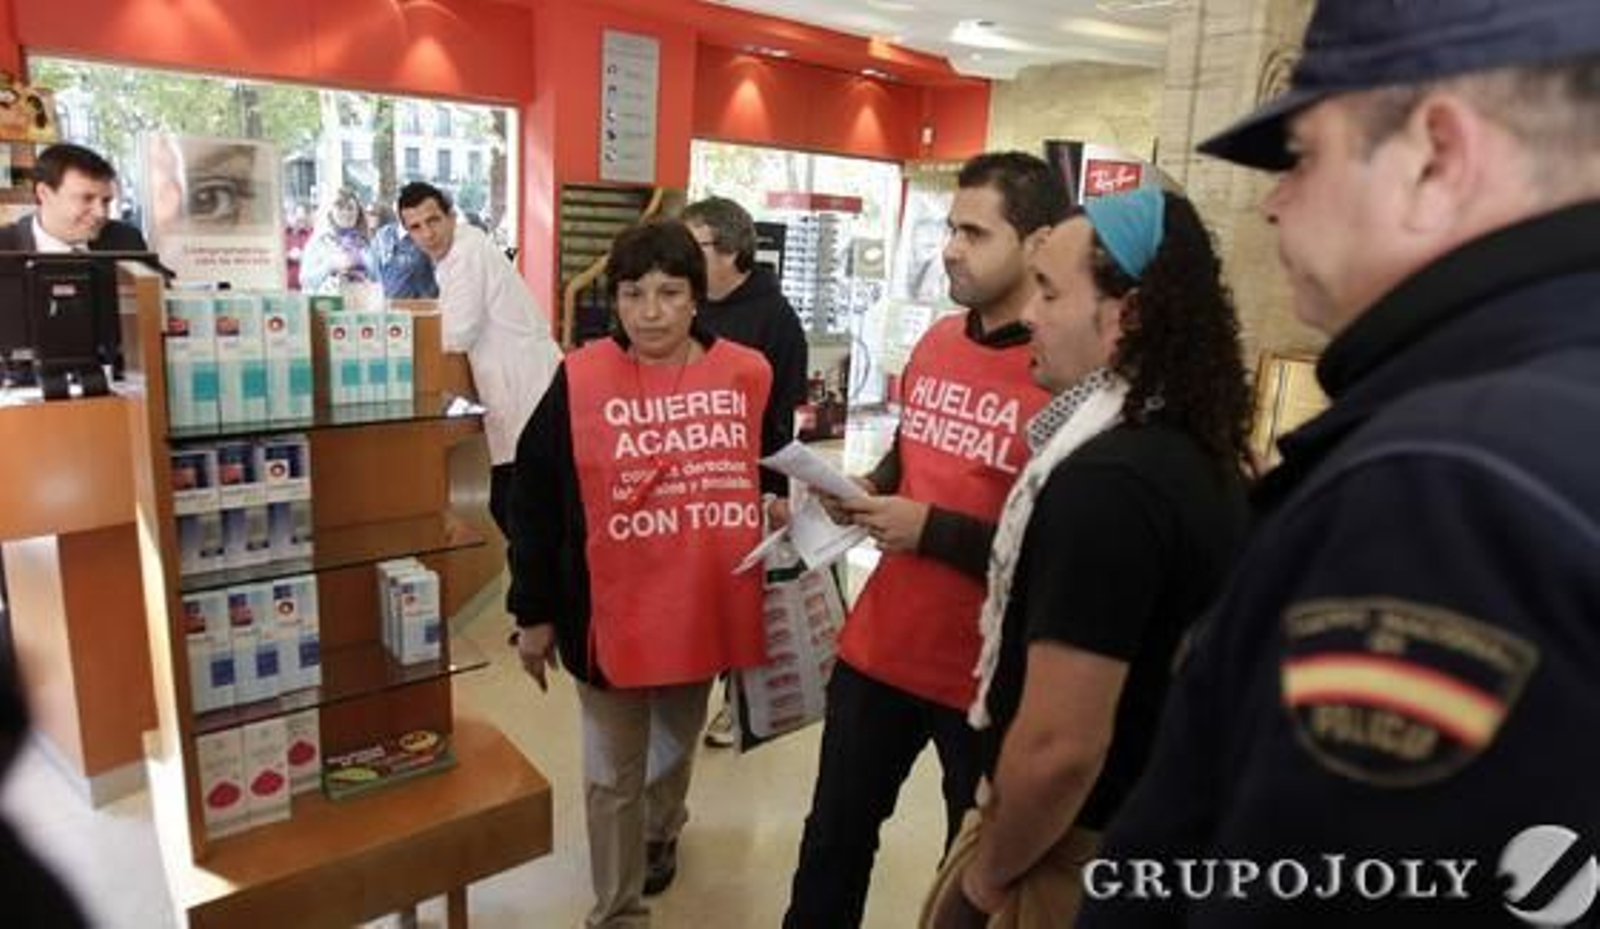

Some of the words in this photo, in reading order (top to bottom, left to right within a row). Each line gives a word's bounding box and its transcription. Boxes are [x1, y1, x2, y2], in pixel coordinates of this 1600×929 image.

[604, 389, 747, 427] QUIEREN
[909, 376, 1020, 434] HUELGA
[615, 422, 747, 460] ACABAR
[901, 406, 1018, 475] GENERAL
[609, 507, 679, 541] CON
[685, 501, 760, 530] TODO
